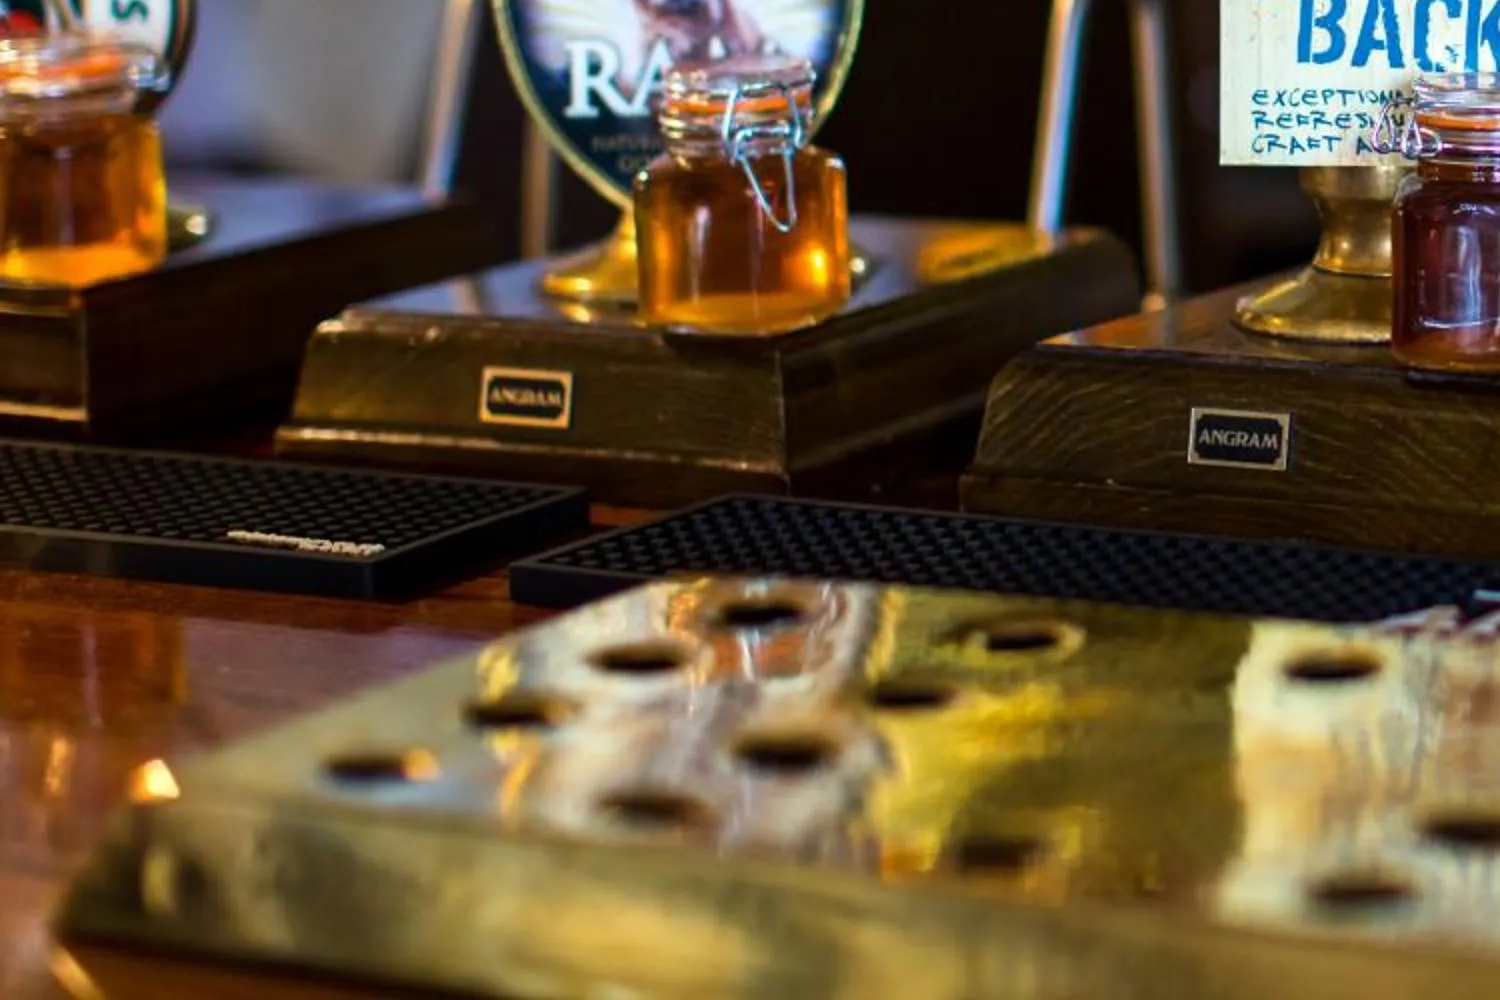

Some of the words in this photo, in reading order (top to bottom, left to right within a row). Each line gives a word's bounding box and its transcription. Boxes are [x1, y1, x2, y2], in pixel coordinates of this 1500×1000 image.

[1251, 88, 1405, 108] EXCEPTION
[1251, 134, 1344, 155] CRAFT
[1199, 427, 1278, 450] ANGRAM
